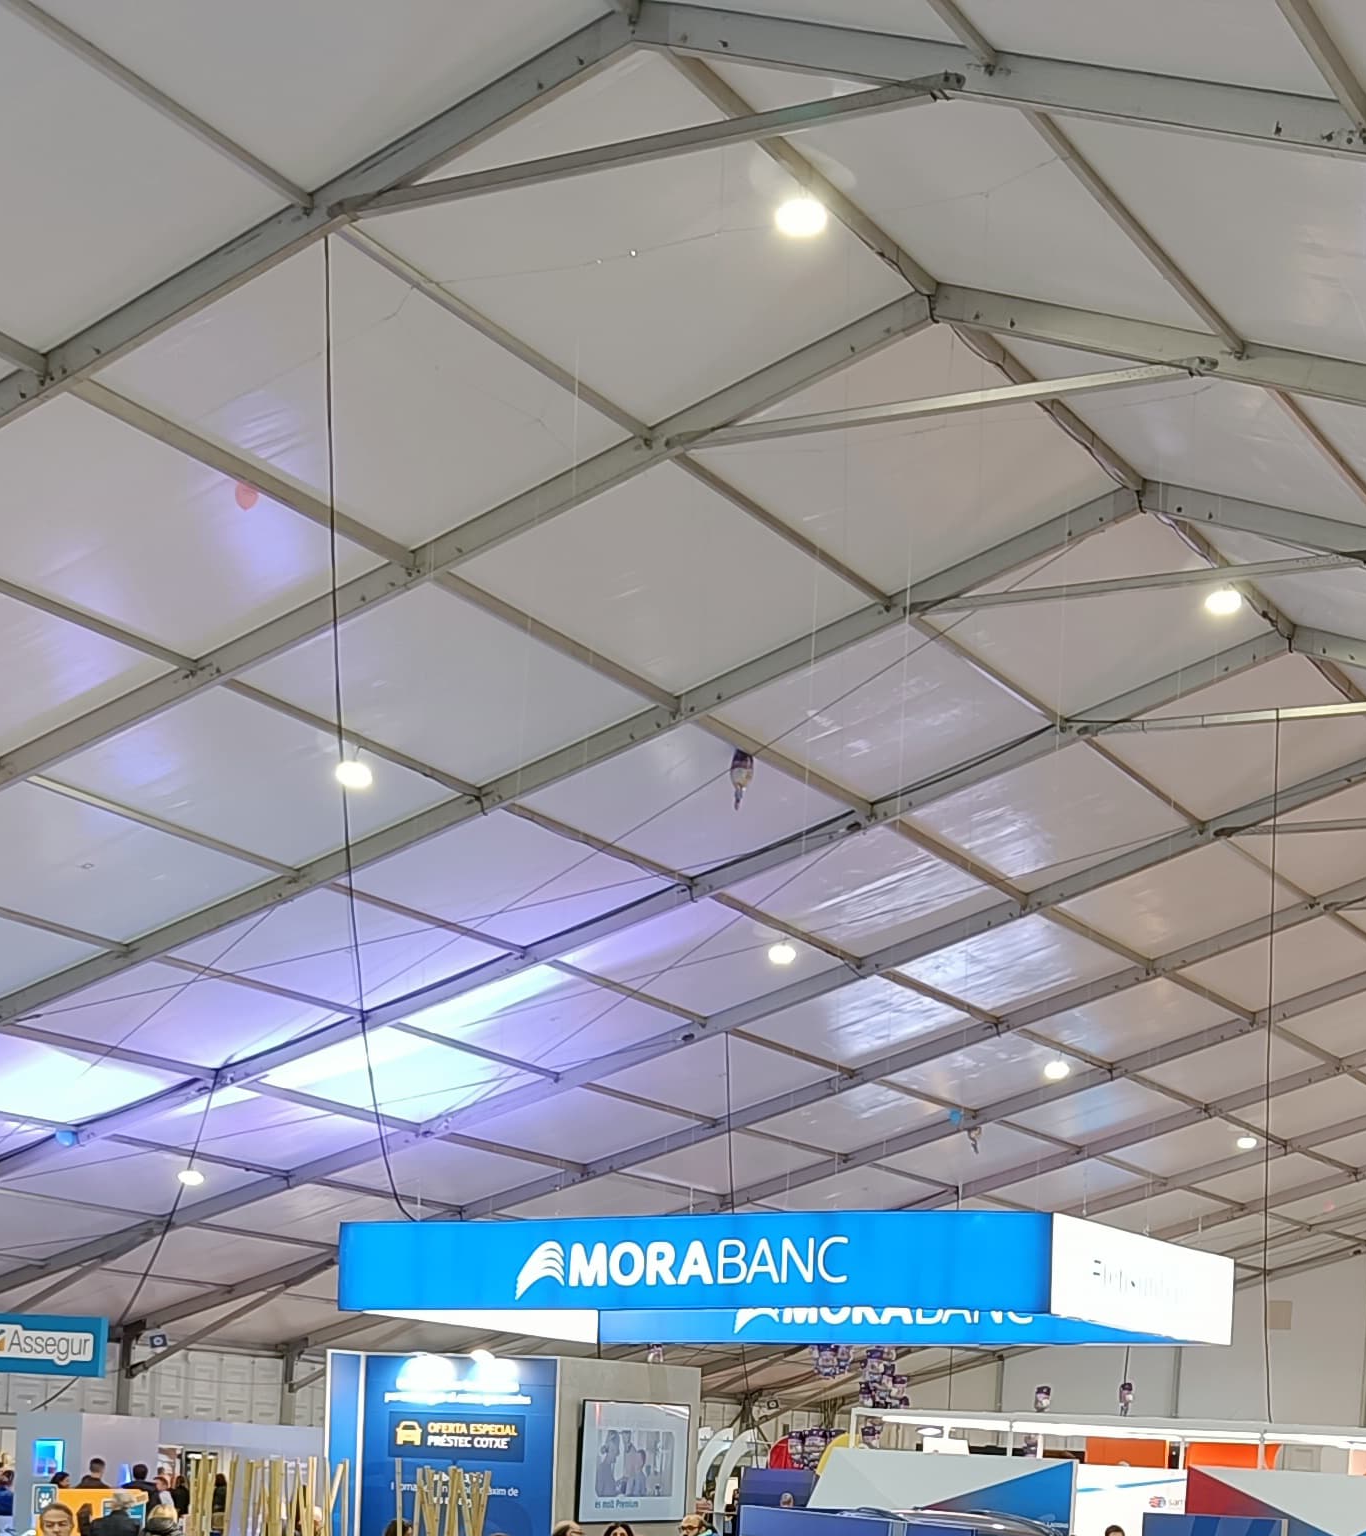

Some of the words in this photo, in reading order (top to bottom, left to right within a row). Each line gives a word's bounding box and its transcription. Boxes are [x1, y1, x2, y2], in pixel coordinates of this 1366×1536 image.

[568, 1235, 849, 1288] MORABANC
[7, 1329, 91, 1362] Assegur
[426, 1433, 472, 1449] PRÉSTEC
[427, 1422, 468, 1435] OFERTA
[469, 1423, 518, 1437] ESPECIAL
